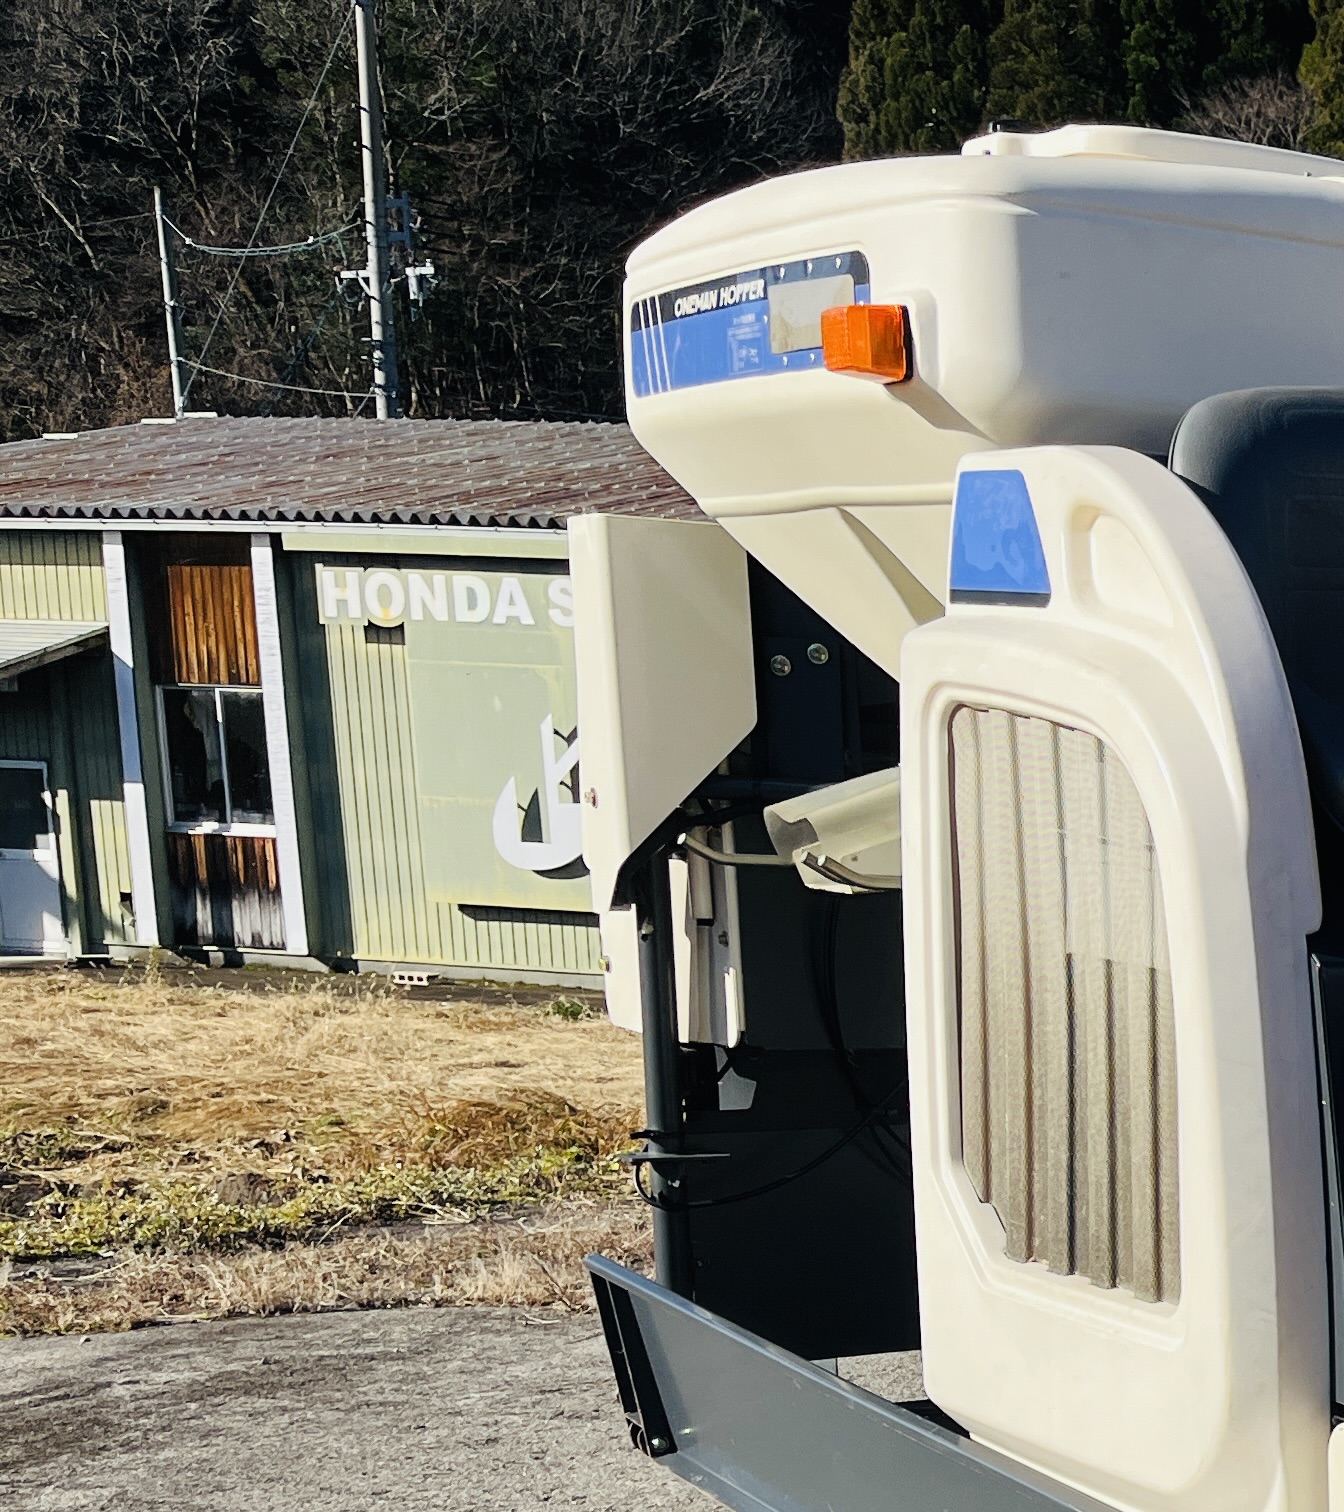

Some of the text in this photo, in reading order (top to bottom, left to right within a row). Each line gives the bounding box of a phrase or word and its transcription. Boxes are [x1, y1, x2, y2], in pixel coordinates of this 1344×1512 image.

[675, 279, 765, 318] ONEMAN HOPPER
[321, 570, 535, 626] HONDA
